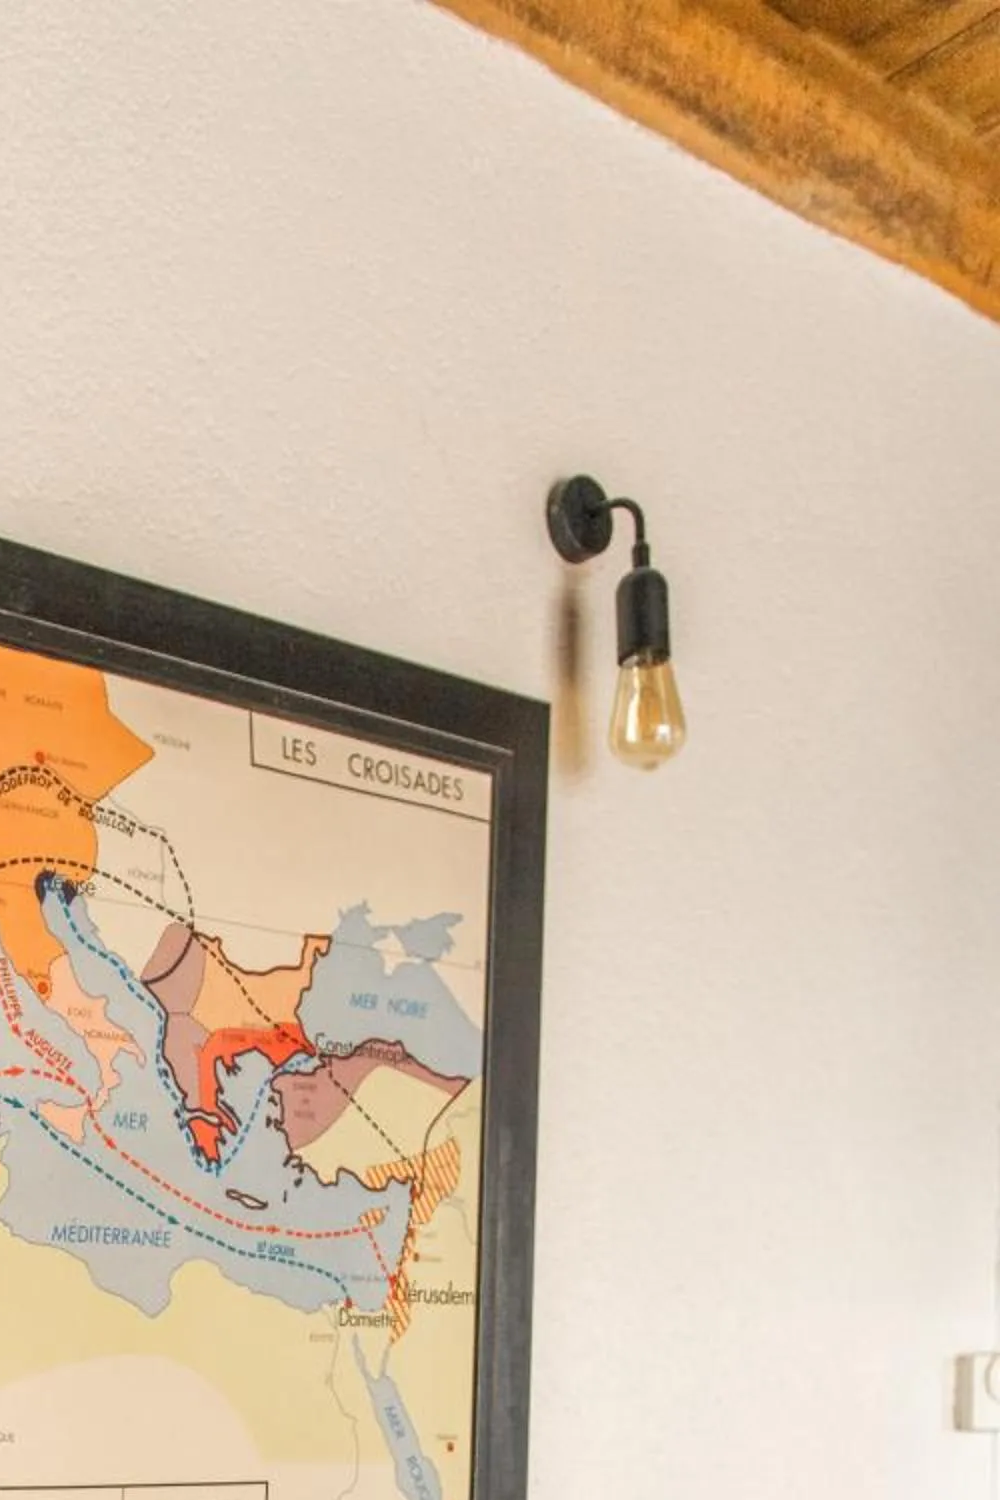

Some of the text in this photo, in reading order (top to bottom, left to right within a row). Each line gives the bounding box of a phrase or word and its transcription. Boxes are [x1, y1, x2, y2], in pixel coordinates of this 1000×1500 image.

[281, 736, 466, 802] LES CROISADES
[78, 806, 136, 839] BOUILLON
[350, 992, 429, 1020] MER NOIRE
[26, 1028, 74, 1071] AUGUSTE
[113, 1112, 147, 1132] MER
[51, 1223, 172, 1248] MÉDITERRANÉE
[339, 1307, 400, 1328] Damiette
